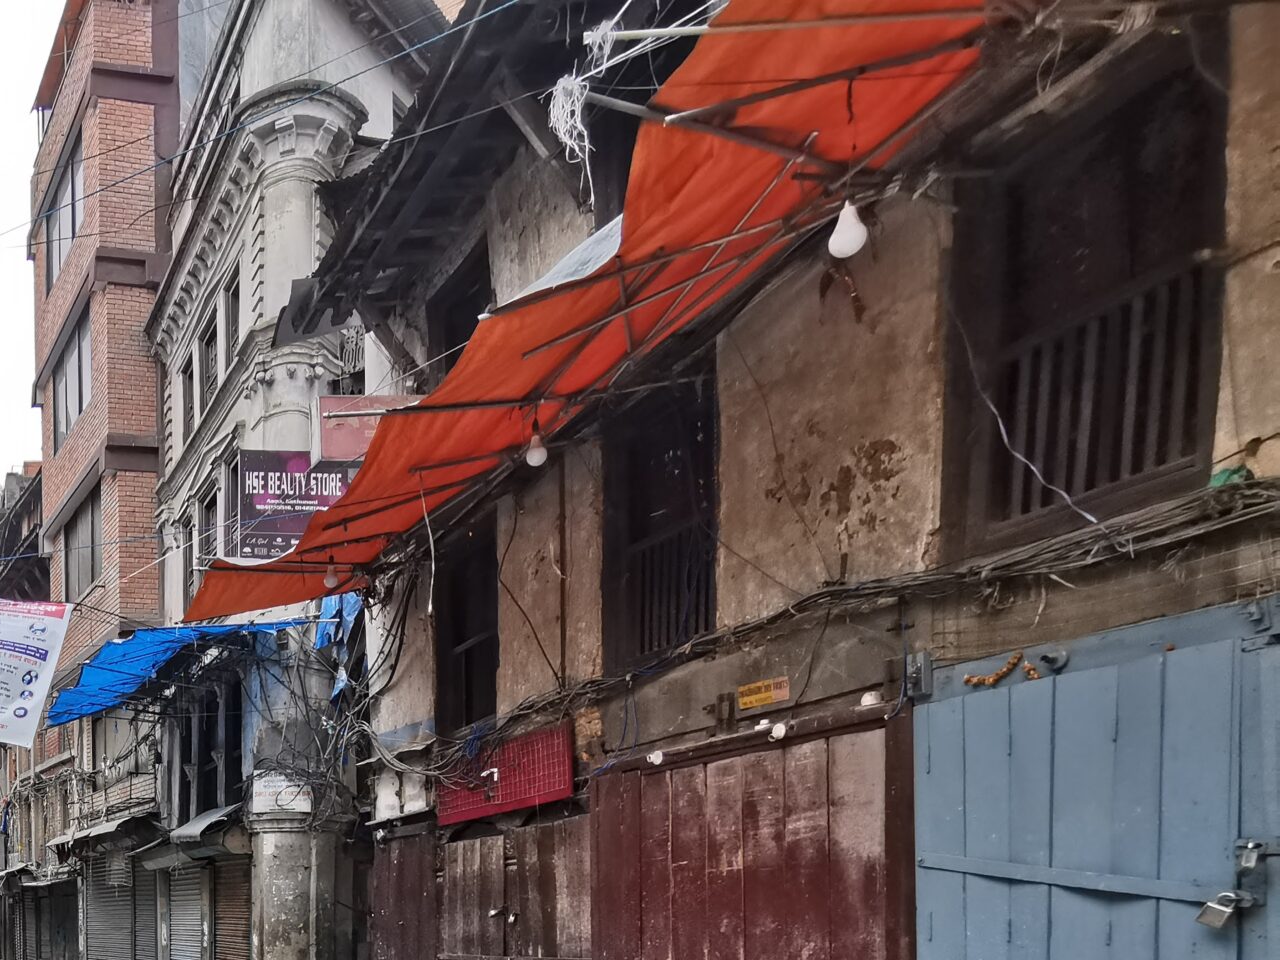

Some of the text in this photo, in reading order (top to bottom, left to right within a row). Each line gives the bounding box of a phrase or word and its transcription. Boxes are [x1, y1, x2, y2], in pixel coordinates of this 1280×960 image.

[245, 471, 342, 496] HSE BEAUTY STORE
